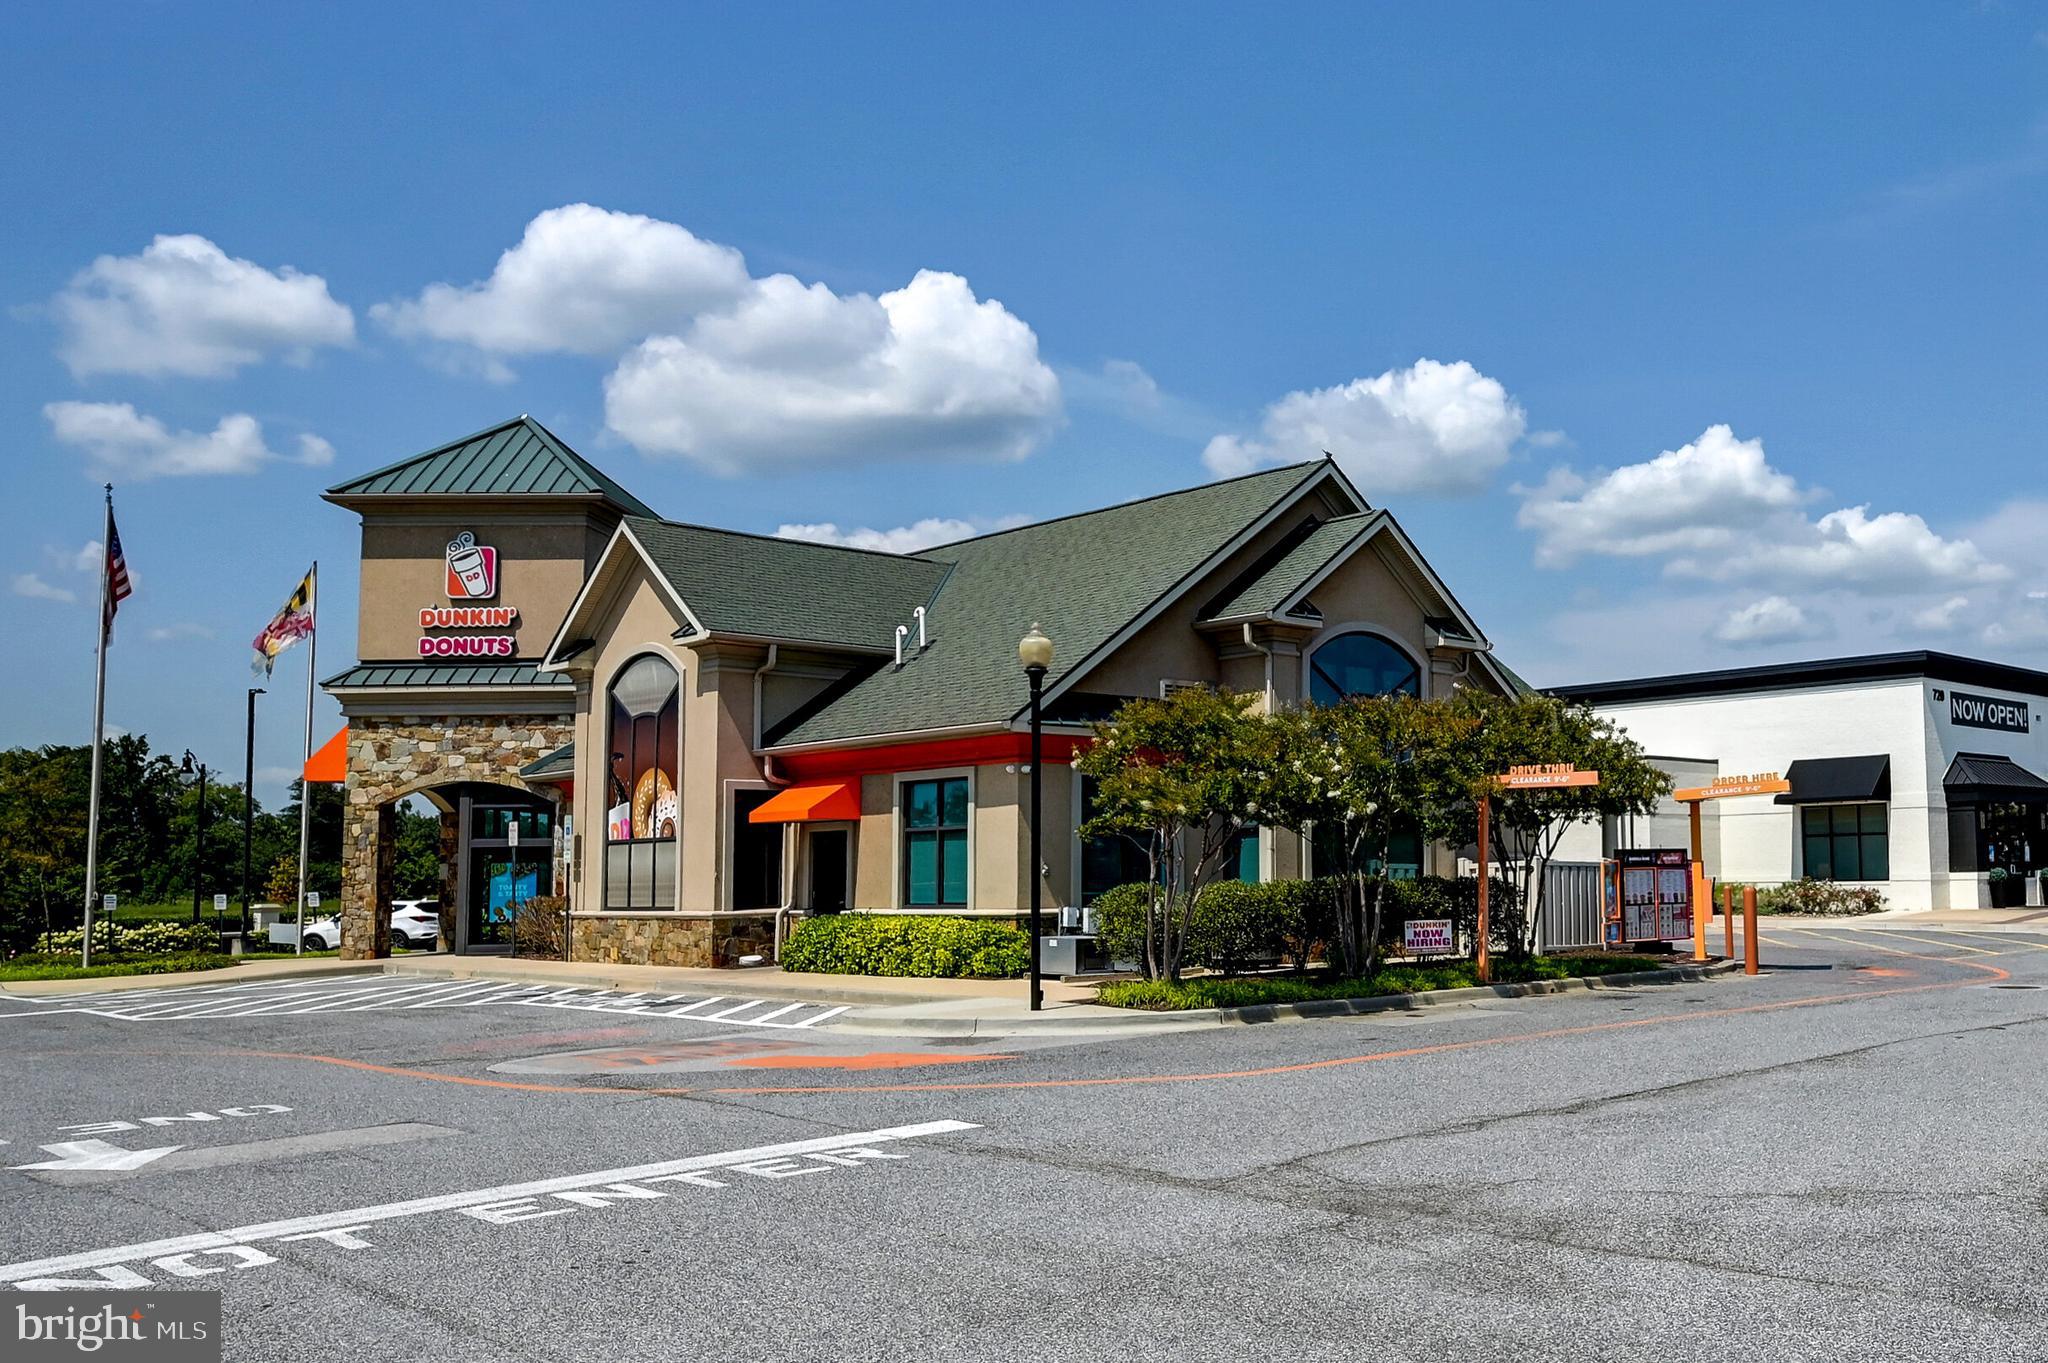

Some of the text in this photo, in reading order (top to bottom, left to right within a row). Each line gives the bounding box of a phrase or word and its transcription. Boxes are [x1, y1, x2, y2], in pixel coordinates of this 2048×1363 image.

[466, 572, 480, 582] DD
[420, 608, 516, 627] DUNKIN'
[419, 637, 511, 655] DONUTS
[1952, 698, 2028, 728] NOW OPEN!
[1510, 763, 1574, 776] DRIVE THRU
[1712, 772, 1780, 786] ORDER HERE
[1701, 787, 1742, 795] CLEARANCE
[1413, 921, 1450, 929] DUNKIN'
[1413, 929, 1444, 939] NOW
[1407, 937, 1451, 947] HIRING
[12, 1147, 910, 1291] NOT ENTER
